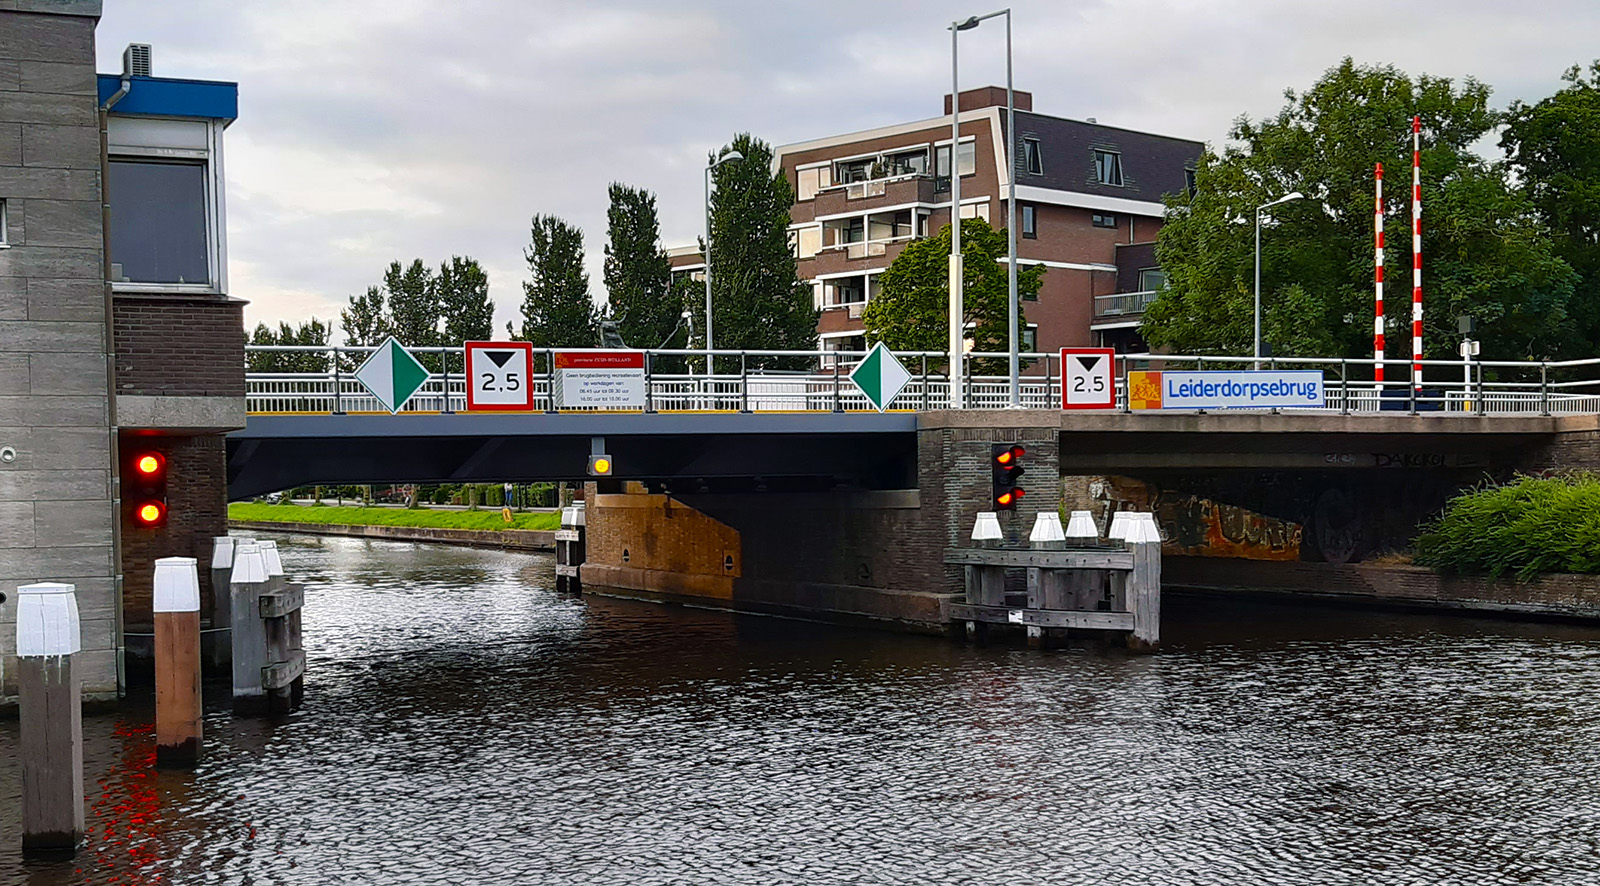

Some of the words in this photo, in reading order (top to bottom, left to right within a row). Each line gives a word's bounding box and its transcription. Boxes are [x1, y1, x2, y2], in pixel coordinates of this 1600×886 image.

[482, 373, 520, 392] 2,5
[1074, 376, 1104, 394] 2,5
[1168, 378, 1317, 400] Leiderdorpsebrug
